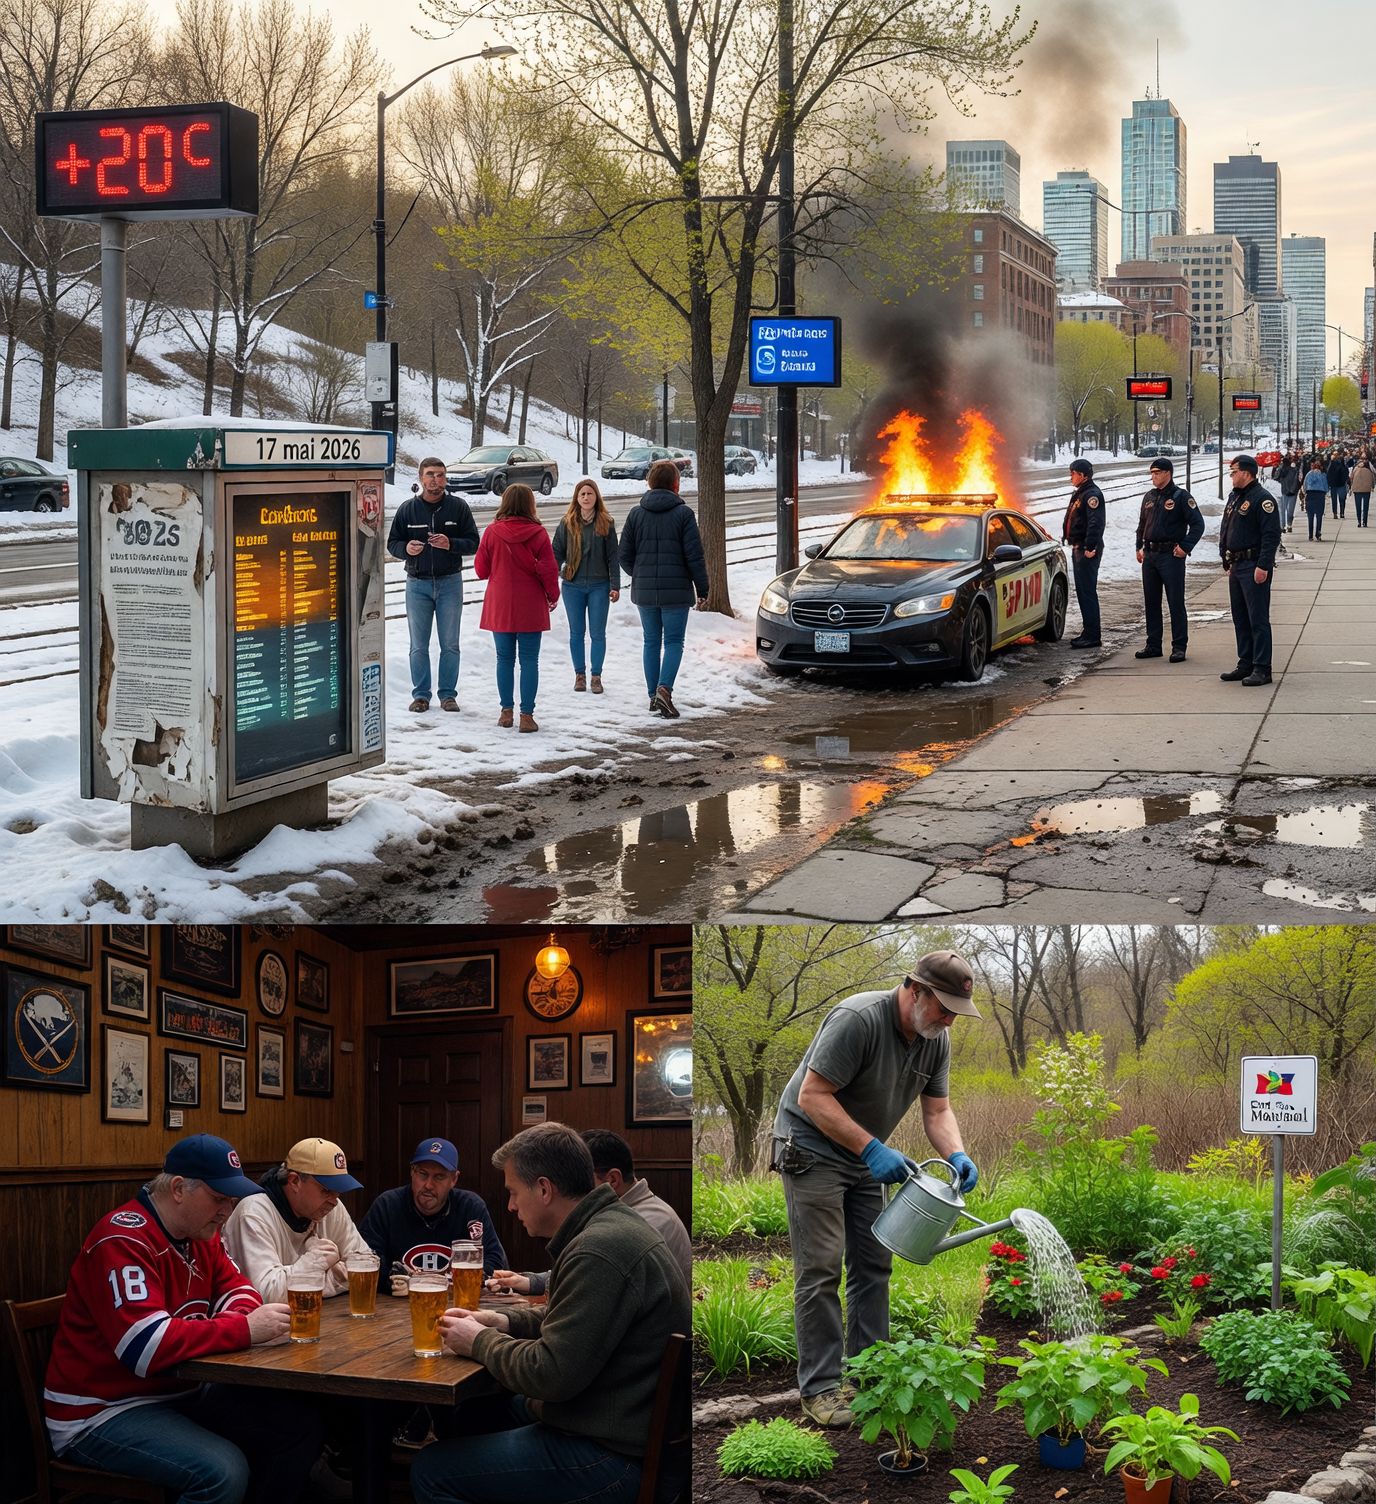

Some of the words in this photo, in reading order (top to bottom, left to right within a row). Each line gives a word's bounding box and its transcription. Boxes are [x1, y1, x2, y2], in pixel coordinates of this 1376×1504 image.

[256, 437, 277, 460] 17
[283, 437, 315, 460] mai
[320, 437, 361, 460] 2026
[108, 1265, 149, 1310] 18
